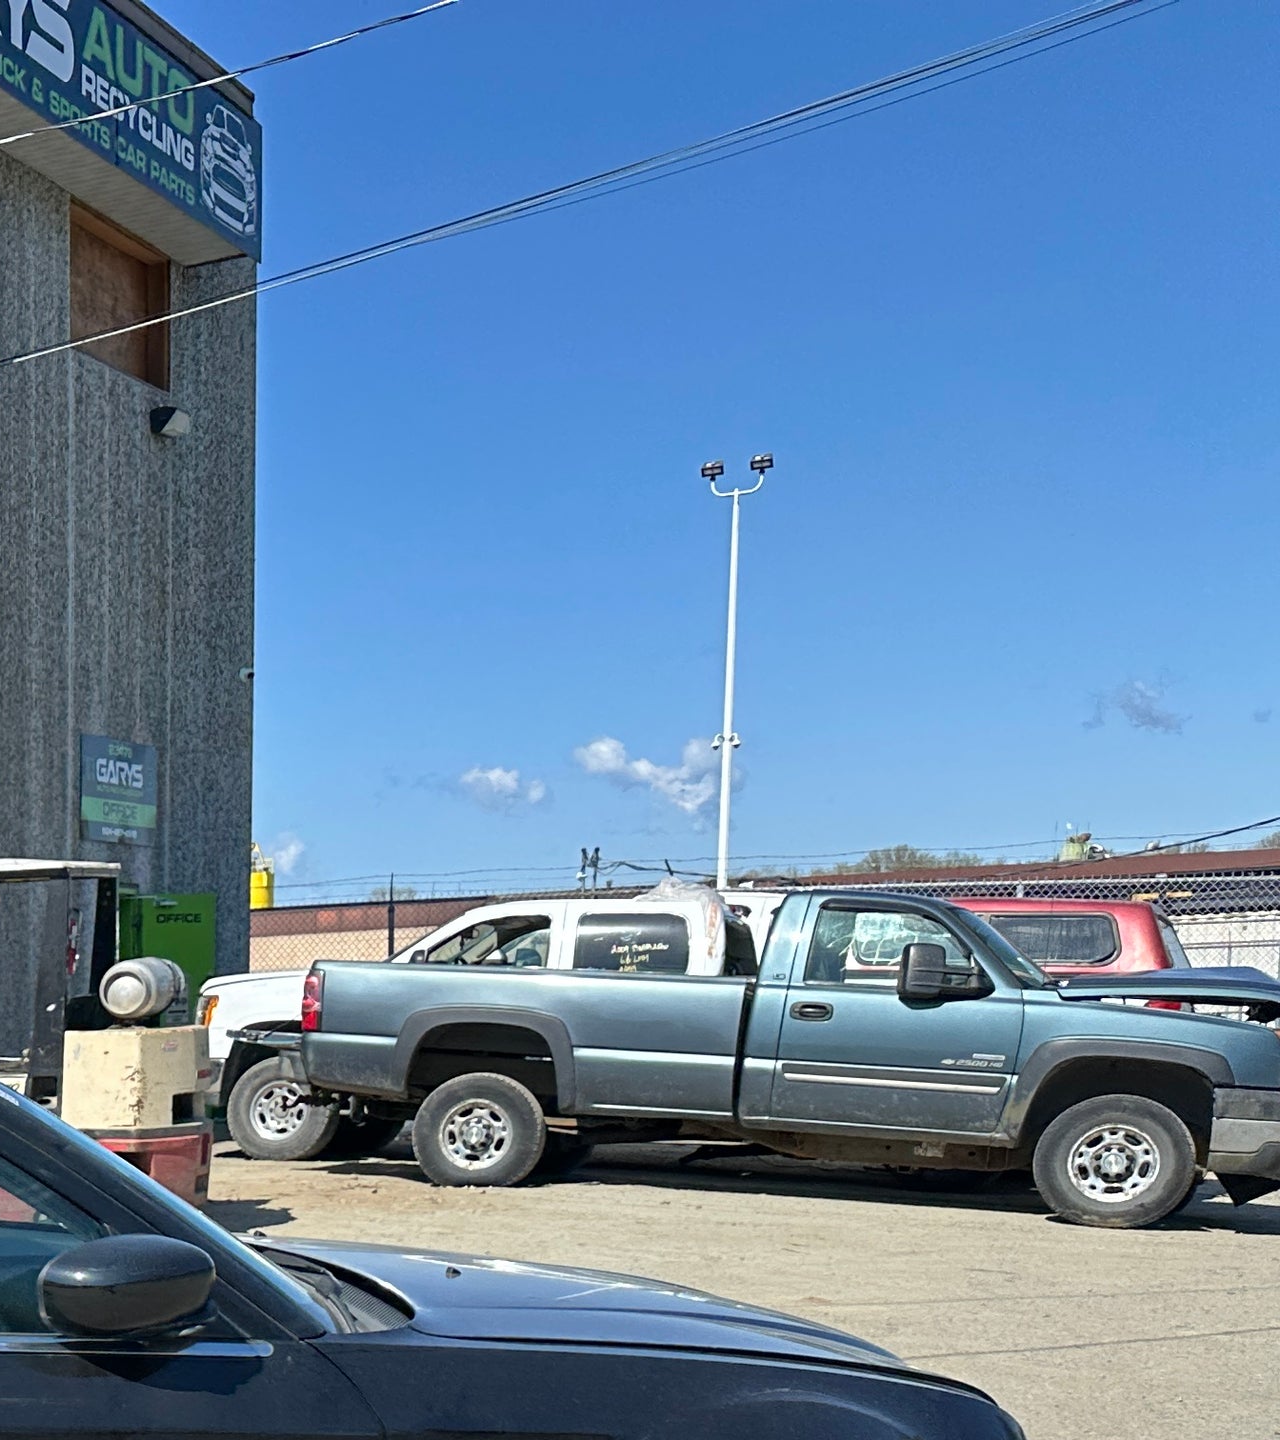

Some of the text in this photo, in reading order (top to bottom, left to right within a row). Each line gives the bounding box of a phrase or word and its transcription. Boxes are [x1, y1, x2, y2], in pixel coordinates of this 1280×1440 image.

[81, 63, 195, 172] RECYCLING
[82, 6, 195, 136] AUTO
[31, 77, 44, 104] &
[49, 90, 111, 150] SPORTS
[116, 136, 146, 174] CAR
[150, 159, 196, 205] PARTS
[96, 758, 144, 789] GARYS
[156, 913, 202, 923] OFFICE
